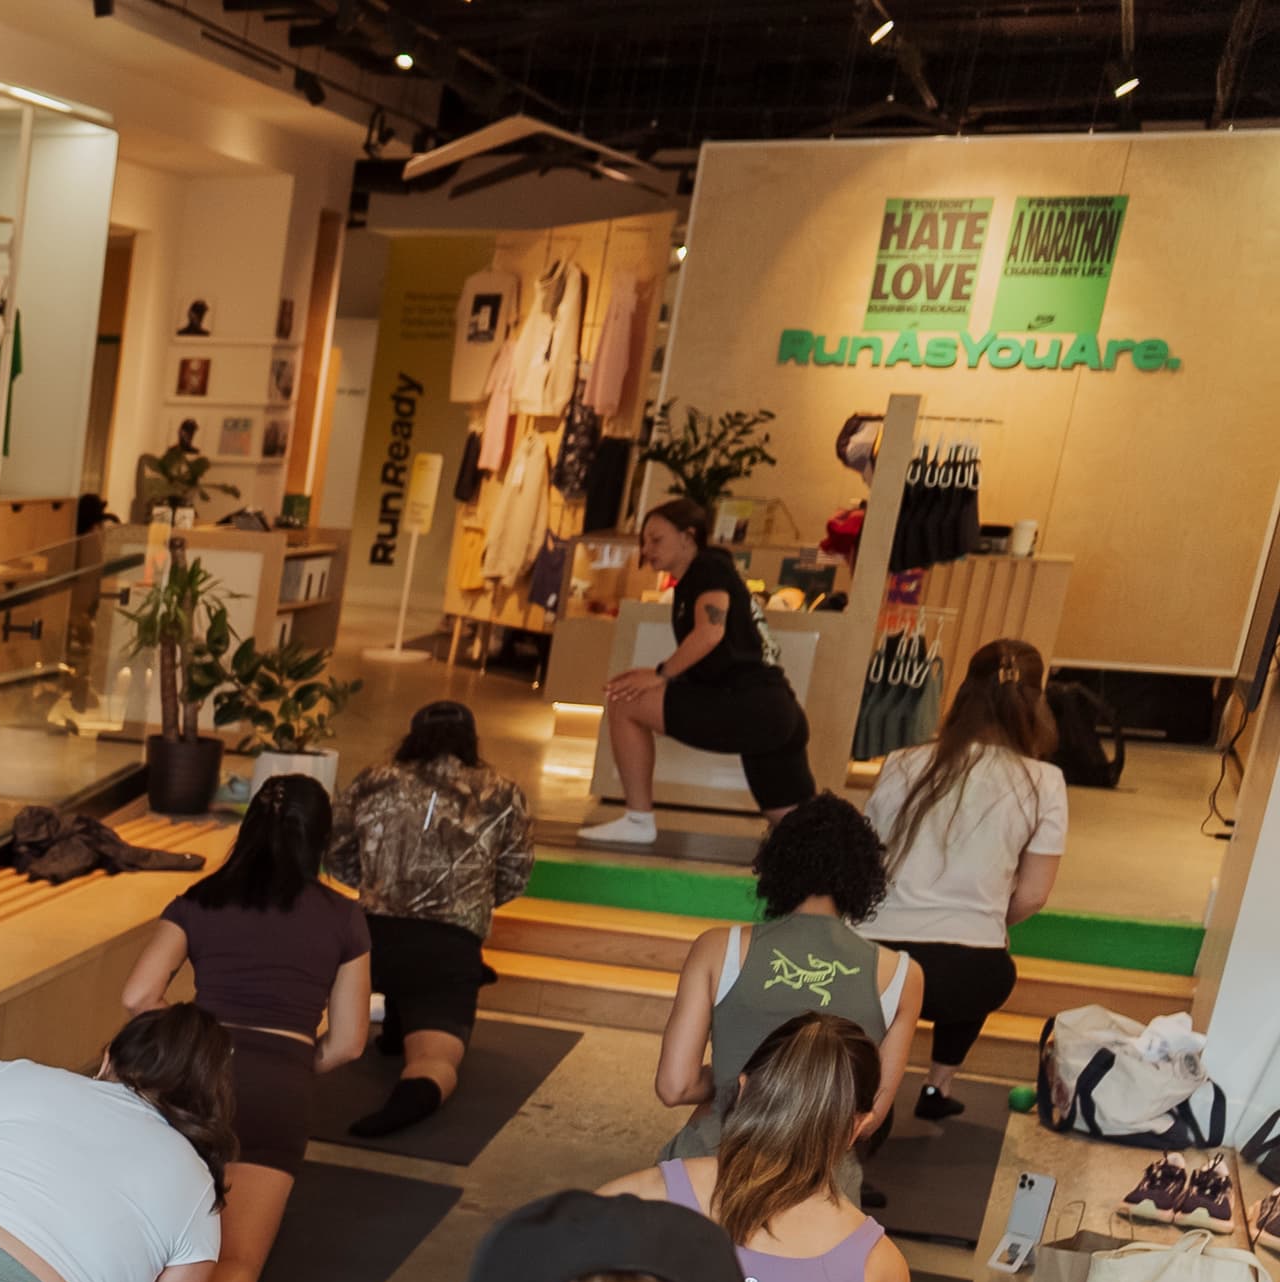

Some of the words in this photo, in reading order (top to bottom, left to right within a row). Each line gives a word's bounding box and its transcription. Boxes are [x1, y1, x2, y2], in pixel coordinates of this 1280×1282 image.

[879, 211, 989, 250] HATE
[1007, 210, 1025, 263] A
[1021, 210, 1123, 264] MARATHON
[870, 263, 978, 301] LOVE
[1004, 266, 1058, 277] CHANGED
[1059, 266, 1080, 277] MY
[866, 304, 917, 314] RUNNING
[778, 328, 1182, 373] RunAsYouAre.
[368, 370, 425, 566] RunReady
